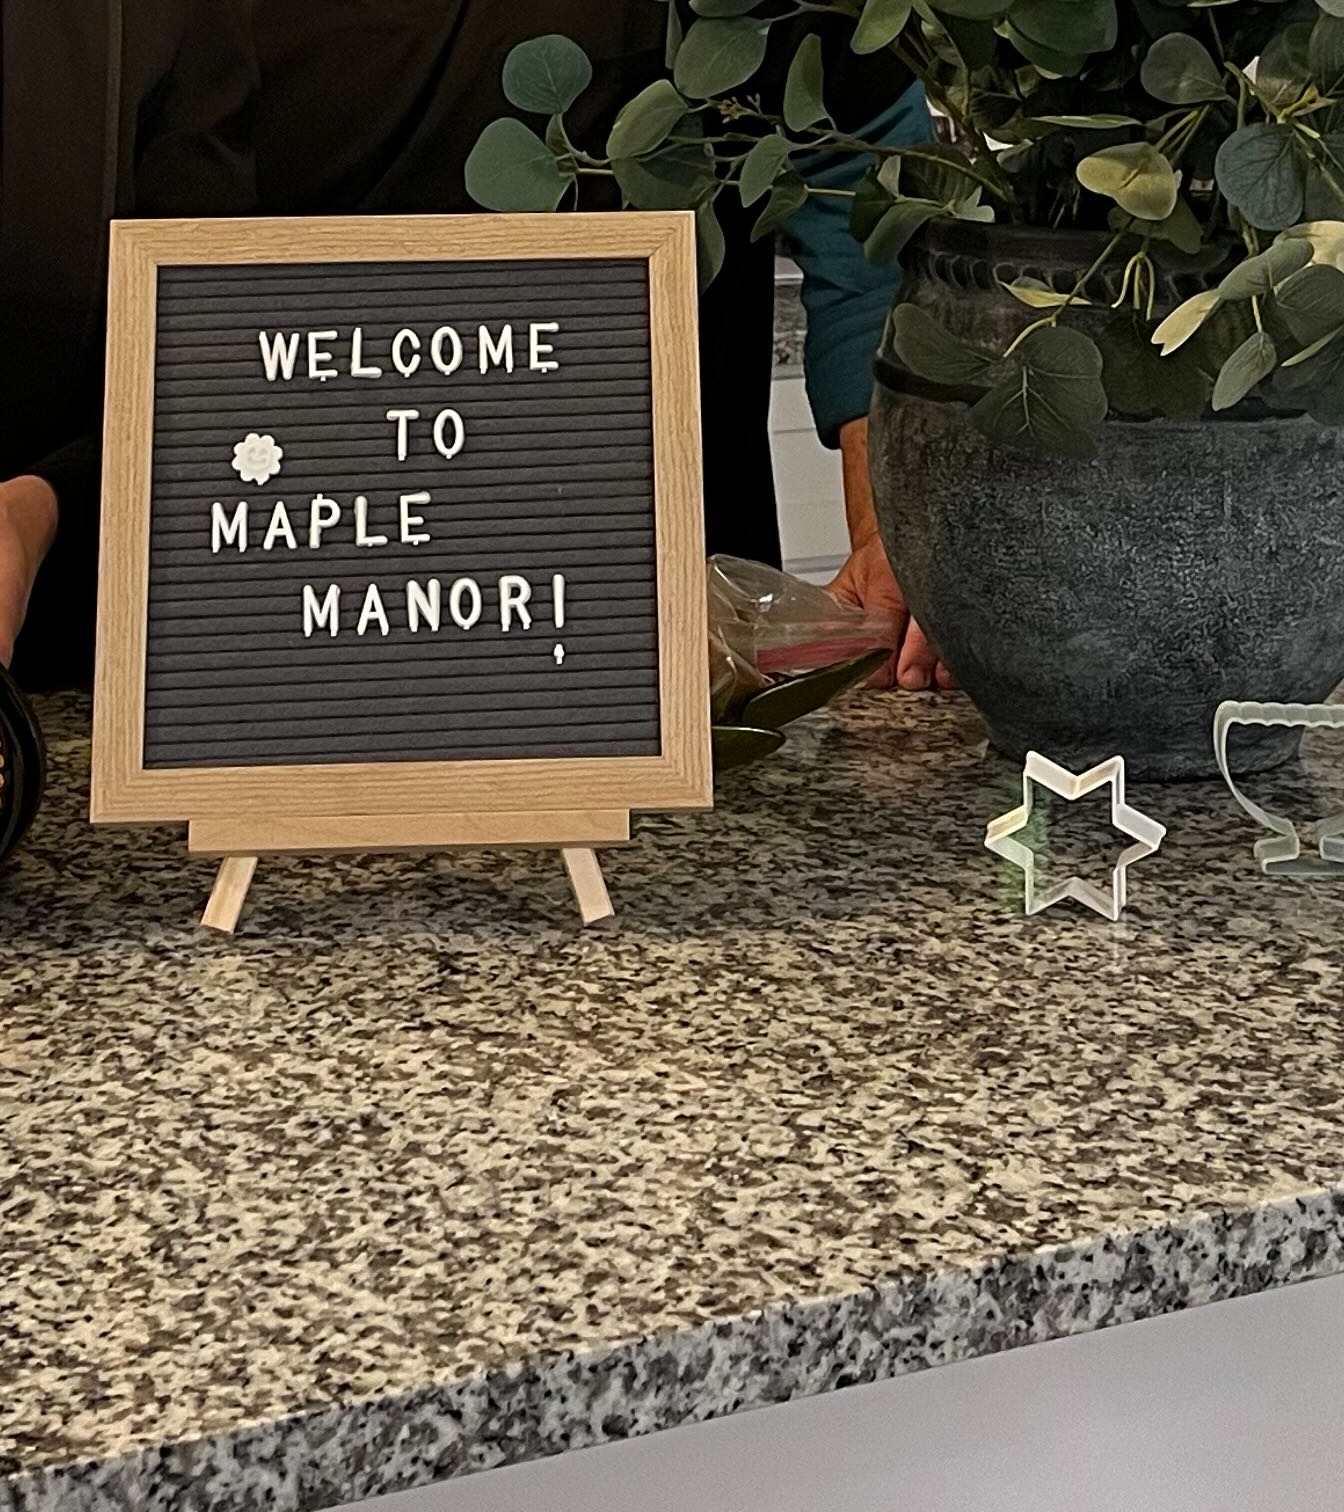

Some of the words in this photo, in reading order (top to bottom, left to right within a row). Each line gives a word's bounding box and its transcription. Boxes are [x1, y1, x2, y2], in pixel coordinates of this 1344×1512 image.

[258, 322, 560, 381] WELCOME
[386, 409, 465, 461] TO
[210, 491, 431, 553] MAPLE
[301, 573, 565, 664] MANOR!
